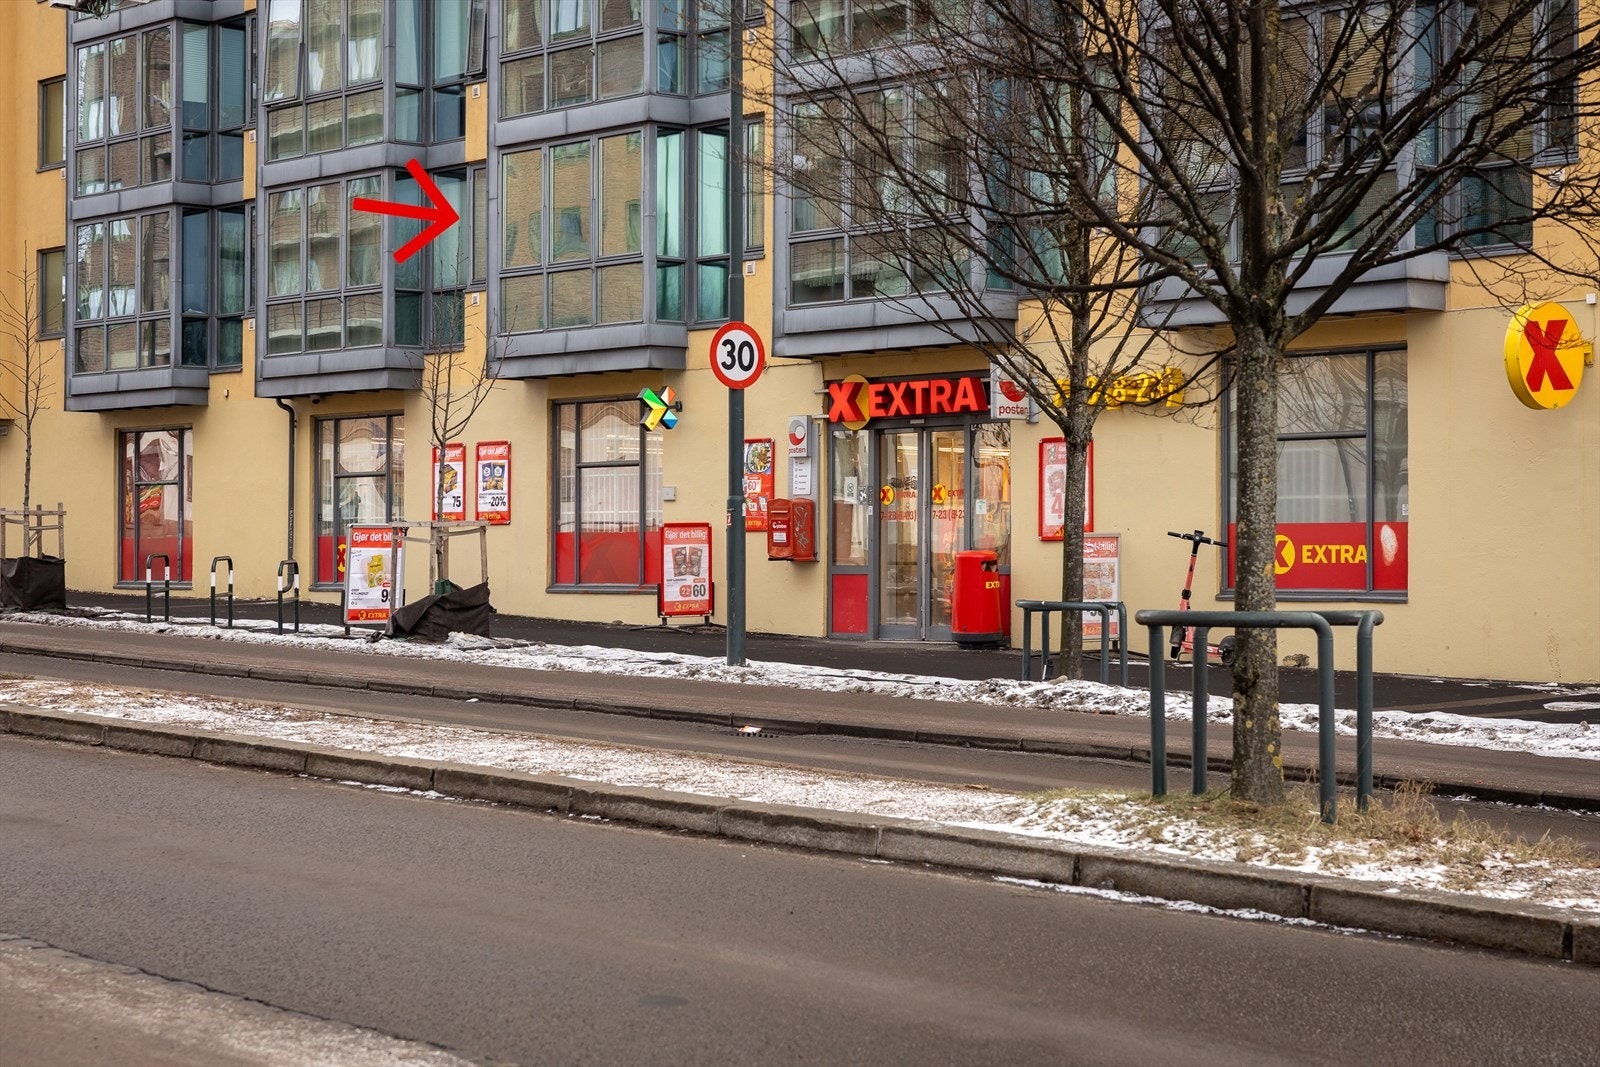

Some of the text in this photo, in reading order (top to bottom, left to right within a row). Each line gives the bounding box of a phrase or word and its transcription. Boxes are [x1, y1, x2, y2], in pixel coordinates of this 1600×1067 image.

[720, 338, 755, 372] 30
[1523, 318, 1575, 393] X
[828, 377, 981, 422] X EXTRA
[998, 403, 1030, 416] posten
[452, 496, 461, 508] 75
[488, 496, 507, 507] -20%
[1051, 493, 1064, 520] 4
[353, 531, 369, 543] Gjør
[369, 531, 382, 542] det
[665, 530, 708, 541] Gjør det billig!
[1301, 544, 1368, 564] EXTRA
[381, 589, 391, 603] 9
[692, 584, 706, 598] 60
